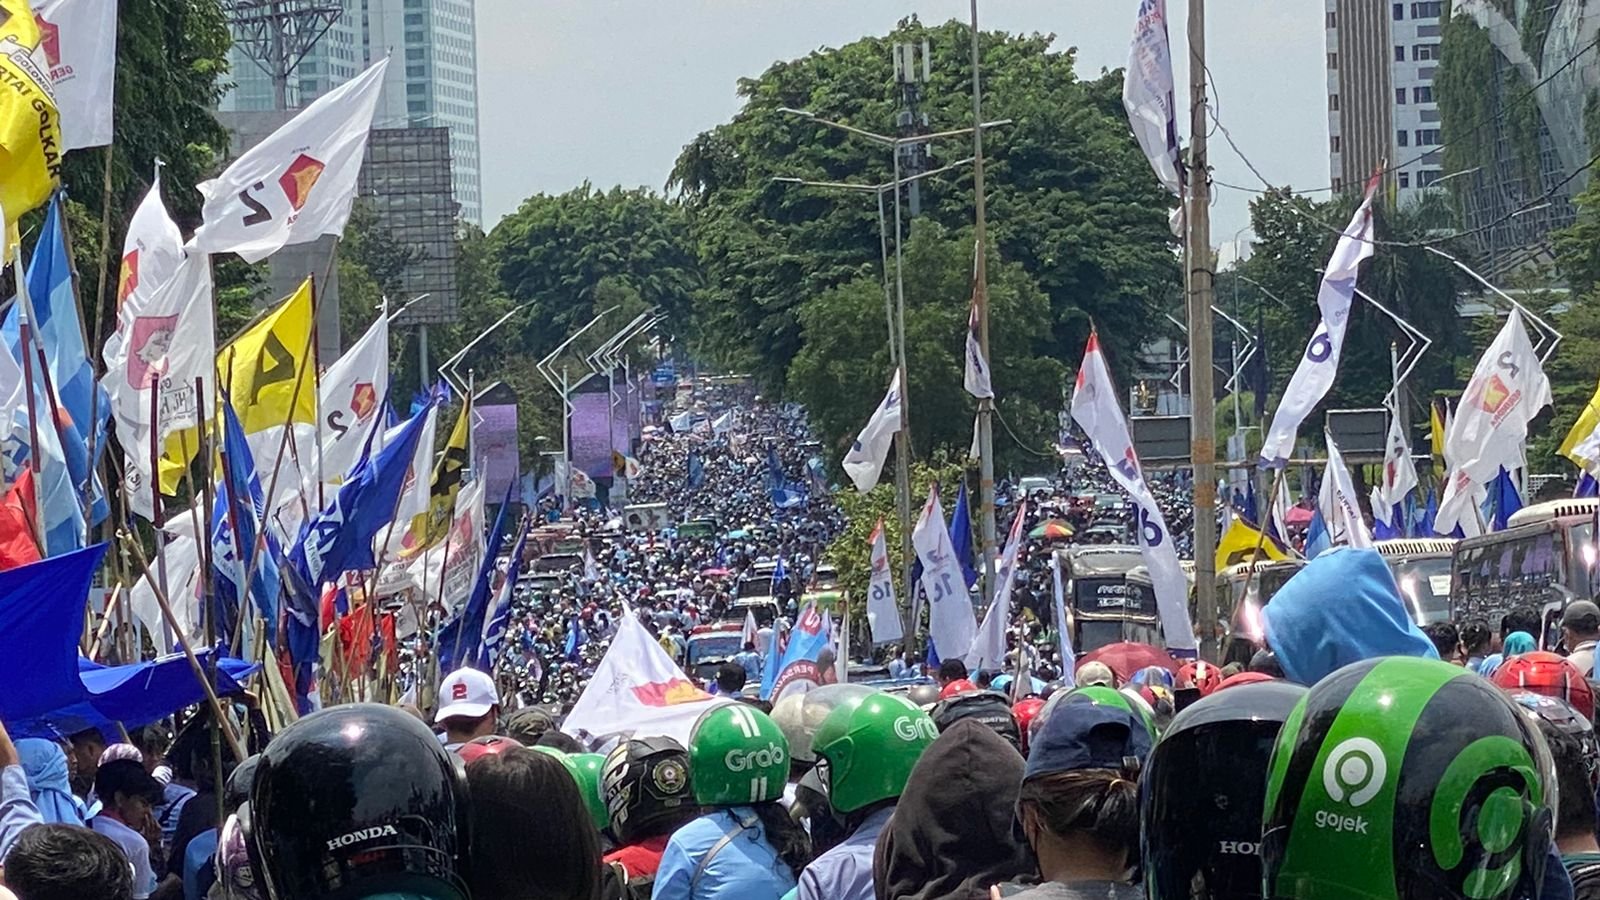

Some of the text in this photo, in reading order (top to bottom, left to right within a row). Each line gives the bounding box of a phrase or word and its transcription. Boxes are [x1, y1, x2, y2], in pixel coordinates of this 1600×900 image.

[31, 98, 61, 179] GOLKAR
[452, 683, 468, 700] 2
[724, 742, 785, 772] Grab
[1314, 809, 1369, 835] gojek
[326, 824, 399, 851] HONDA
